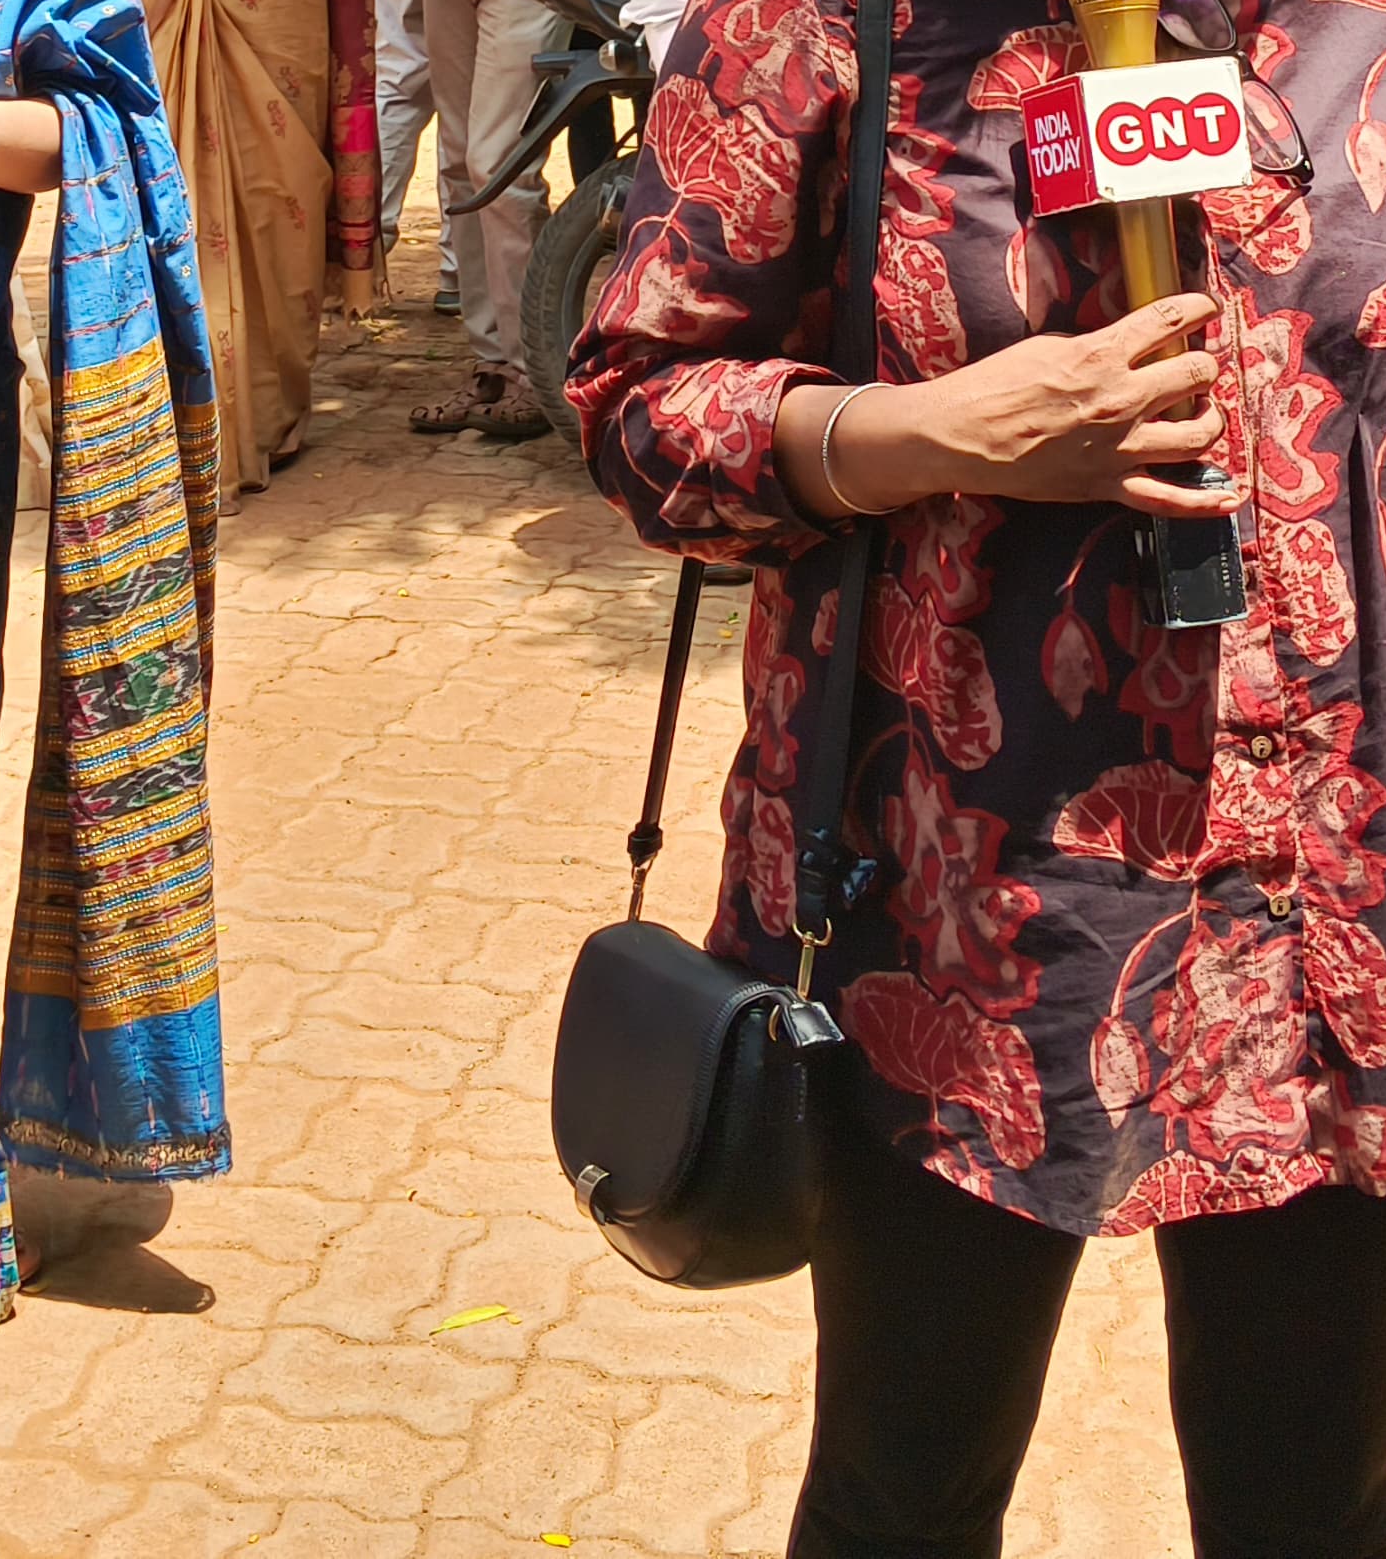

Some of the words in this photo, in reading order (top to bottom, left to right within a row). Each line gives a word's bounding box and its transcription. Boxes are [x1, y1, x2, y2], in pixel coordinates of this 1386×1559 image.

[1034, 110, 1073, 144] INDIA
[1107, 104, 1227, 154] GNT
[1031, 136, 1081, 178] TODAY
